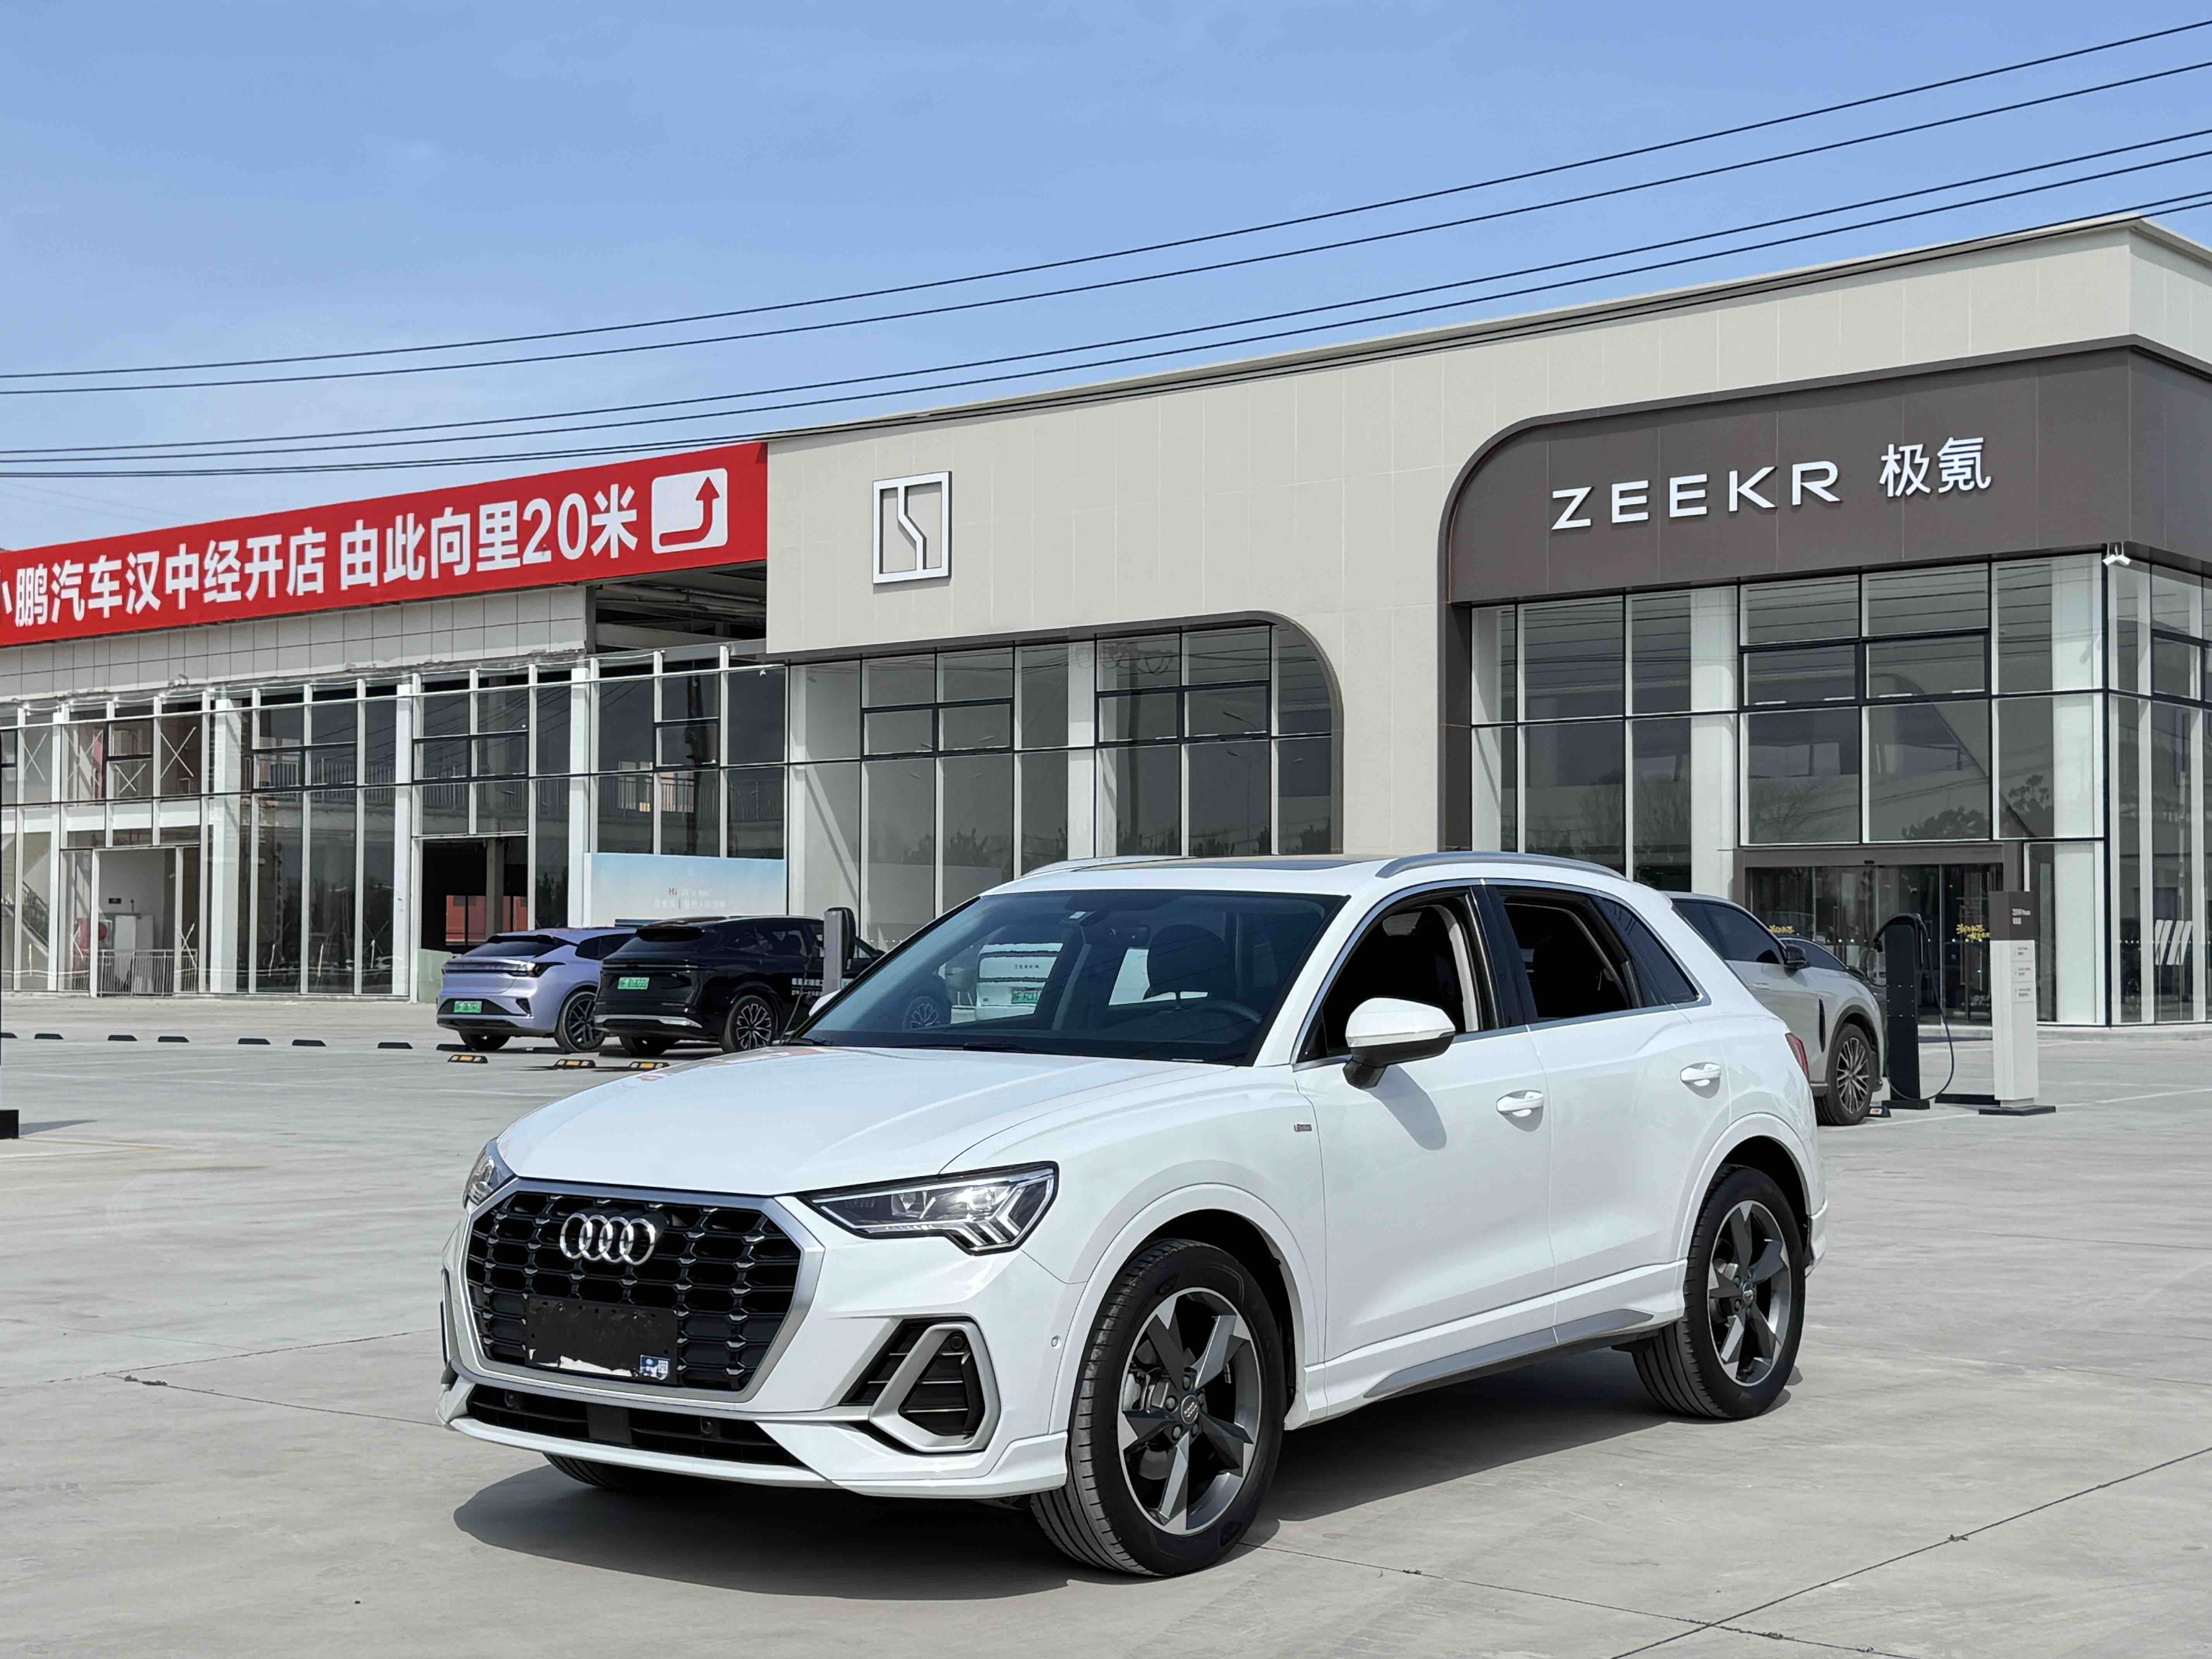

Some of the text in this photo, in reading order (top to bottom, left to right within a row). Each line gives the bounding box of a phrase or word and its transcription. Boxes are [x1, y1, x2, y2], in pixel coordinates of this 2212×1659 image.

[1551, 436, 1992, 530] ZEEKR 极氪
[340, 484, 638, 591] 由此向里20米
